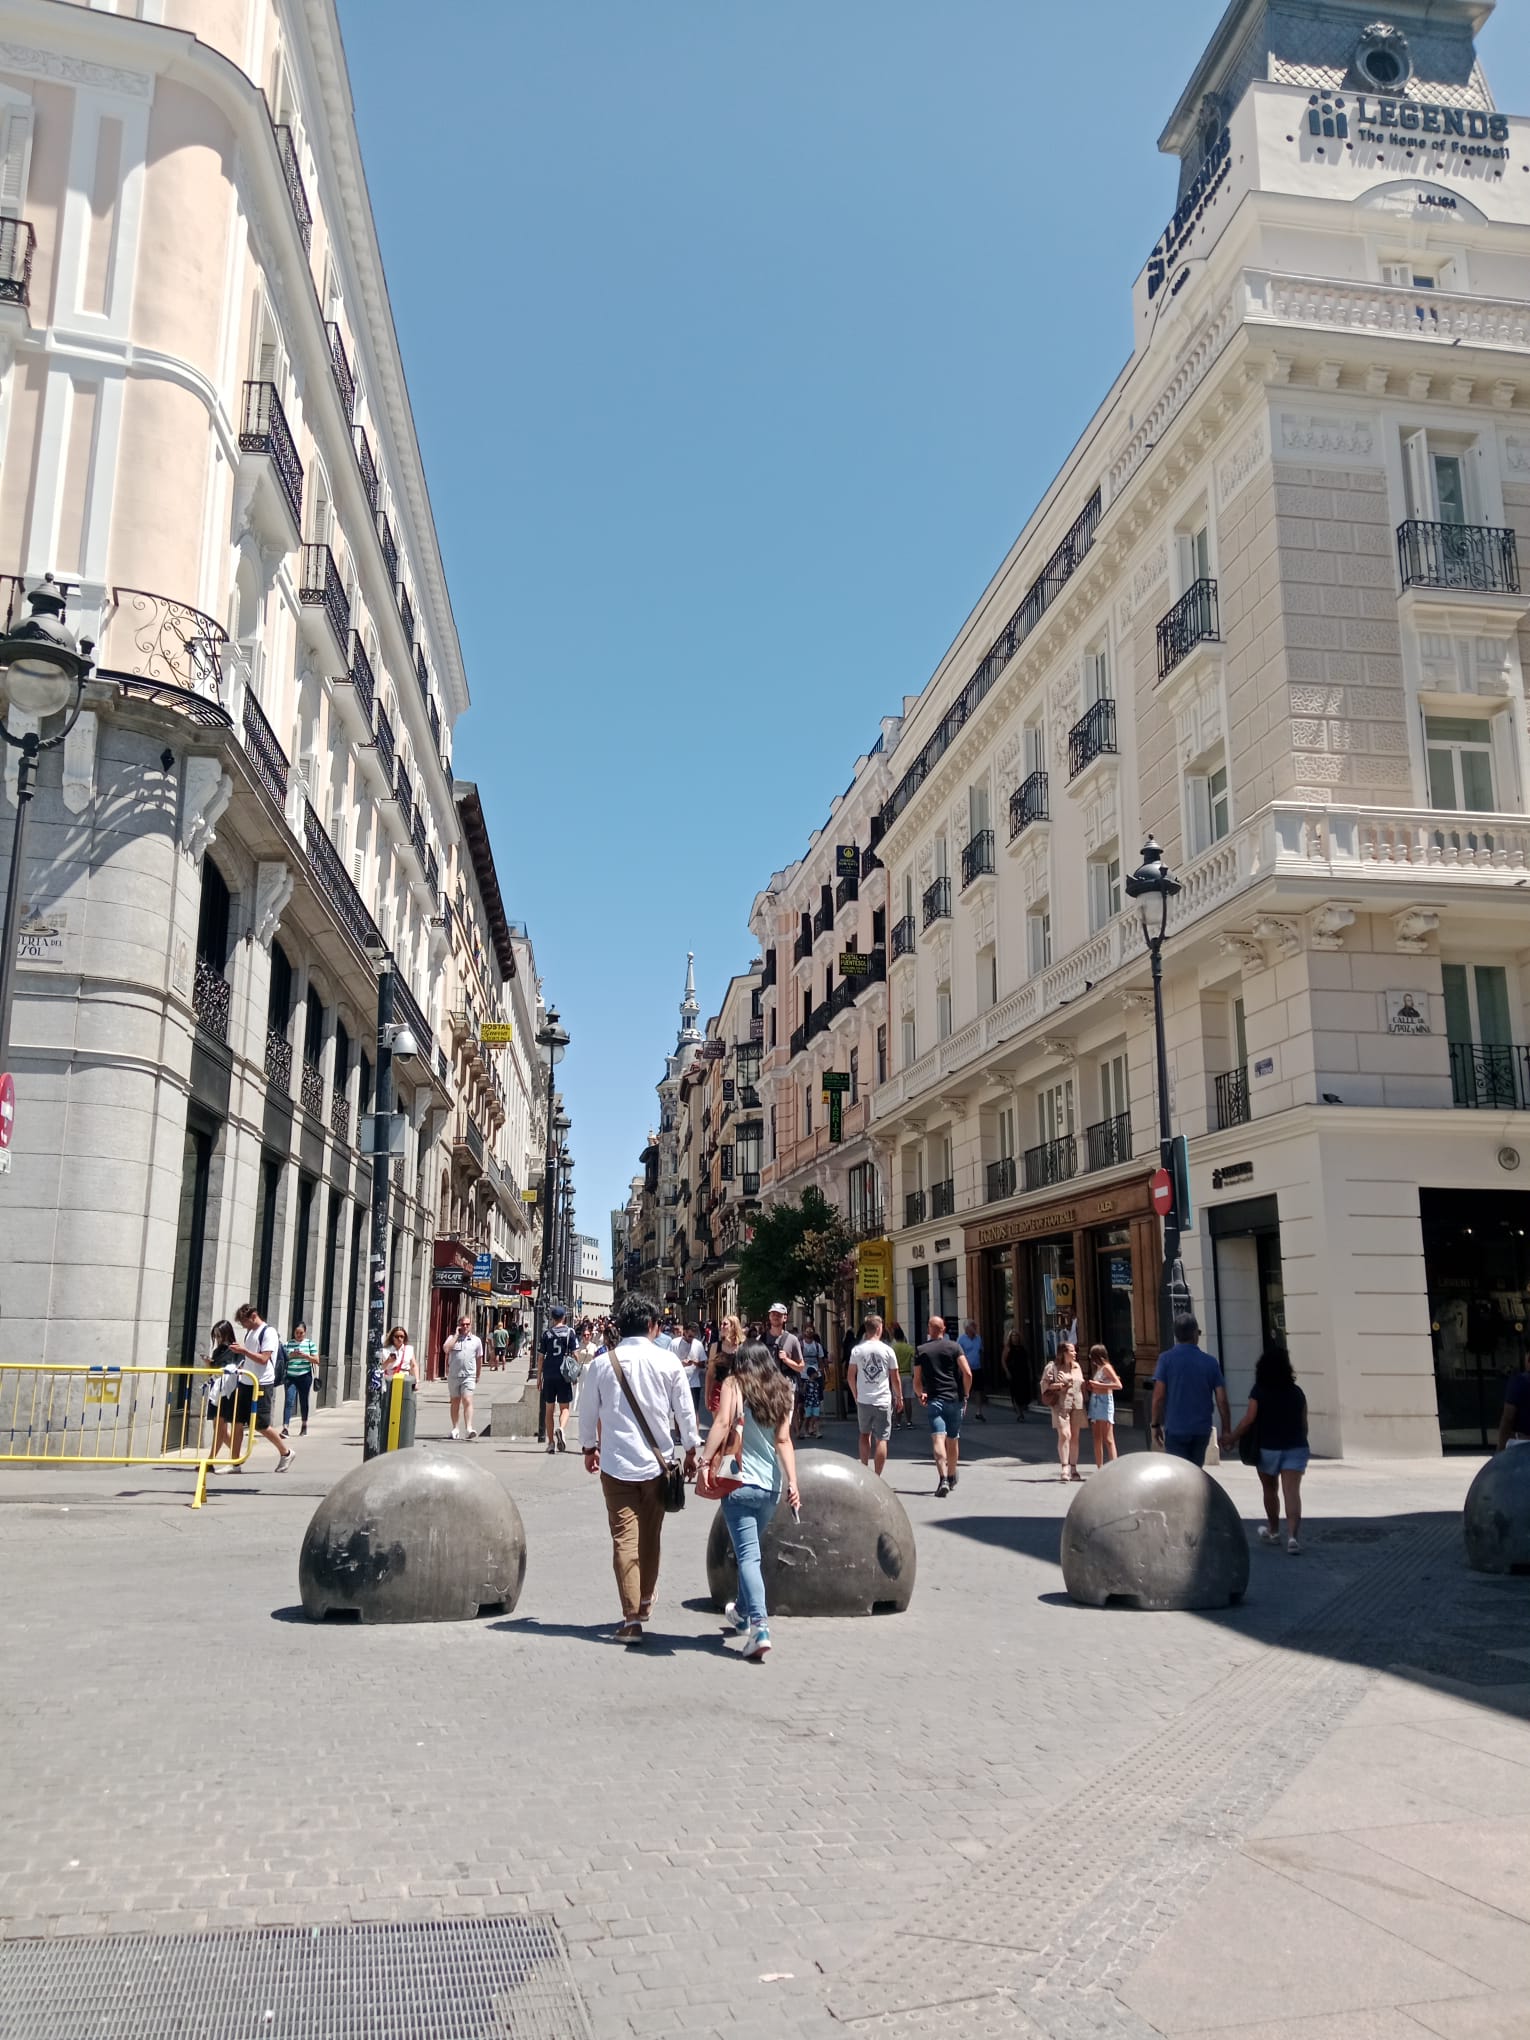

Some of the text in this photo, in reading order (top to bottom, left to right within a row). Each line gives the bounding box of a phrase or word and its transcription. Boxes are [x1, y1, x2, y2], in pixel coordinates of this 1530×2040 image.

[1356, 97, 1509, 141] LEGENDS
[1358, 129, 1510, 160] The Home of Football
[553, 1338, 562, 1356] 5
